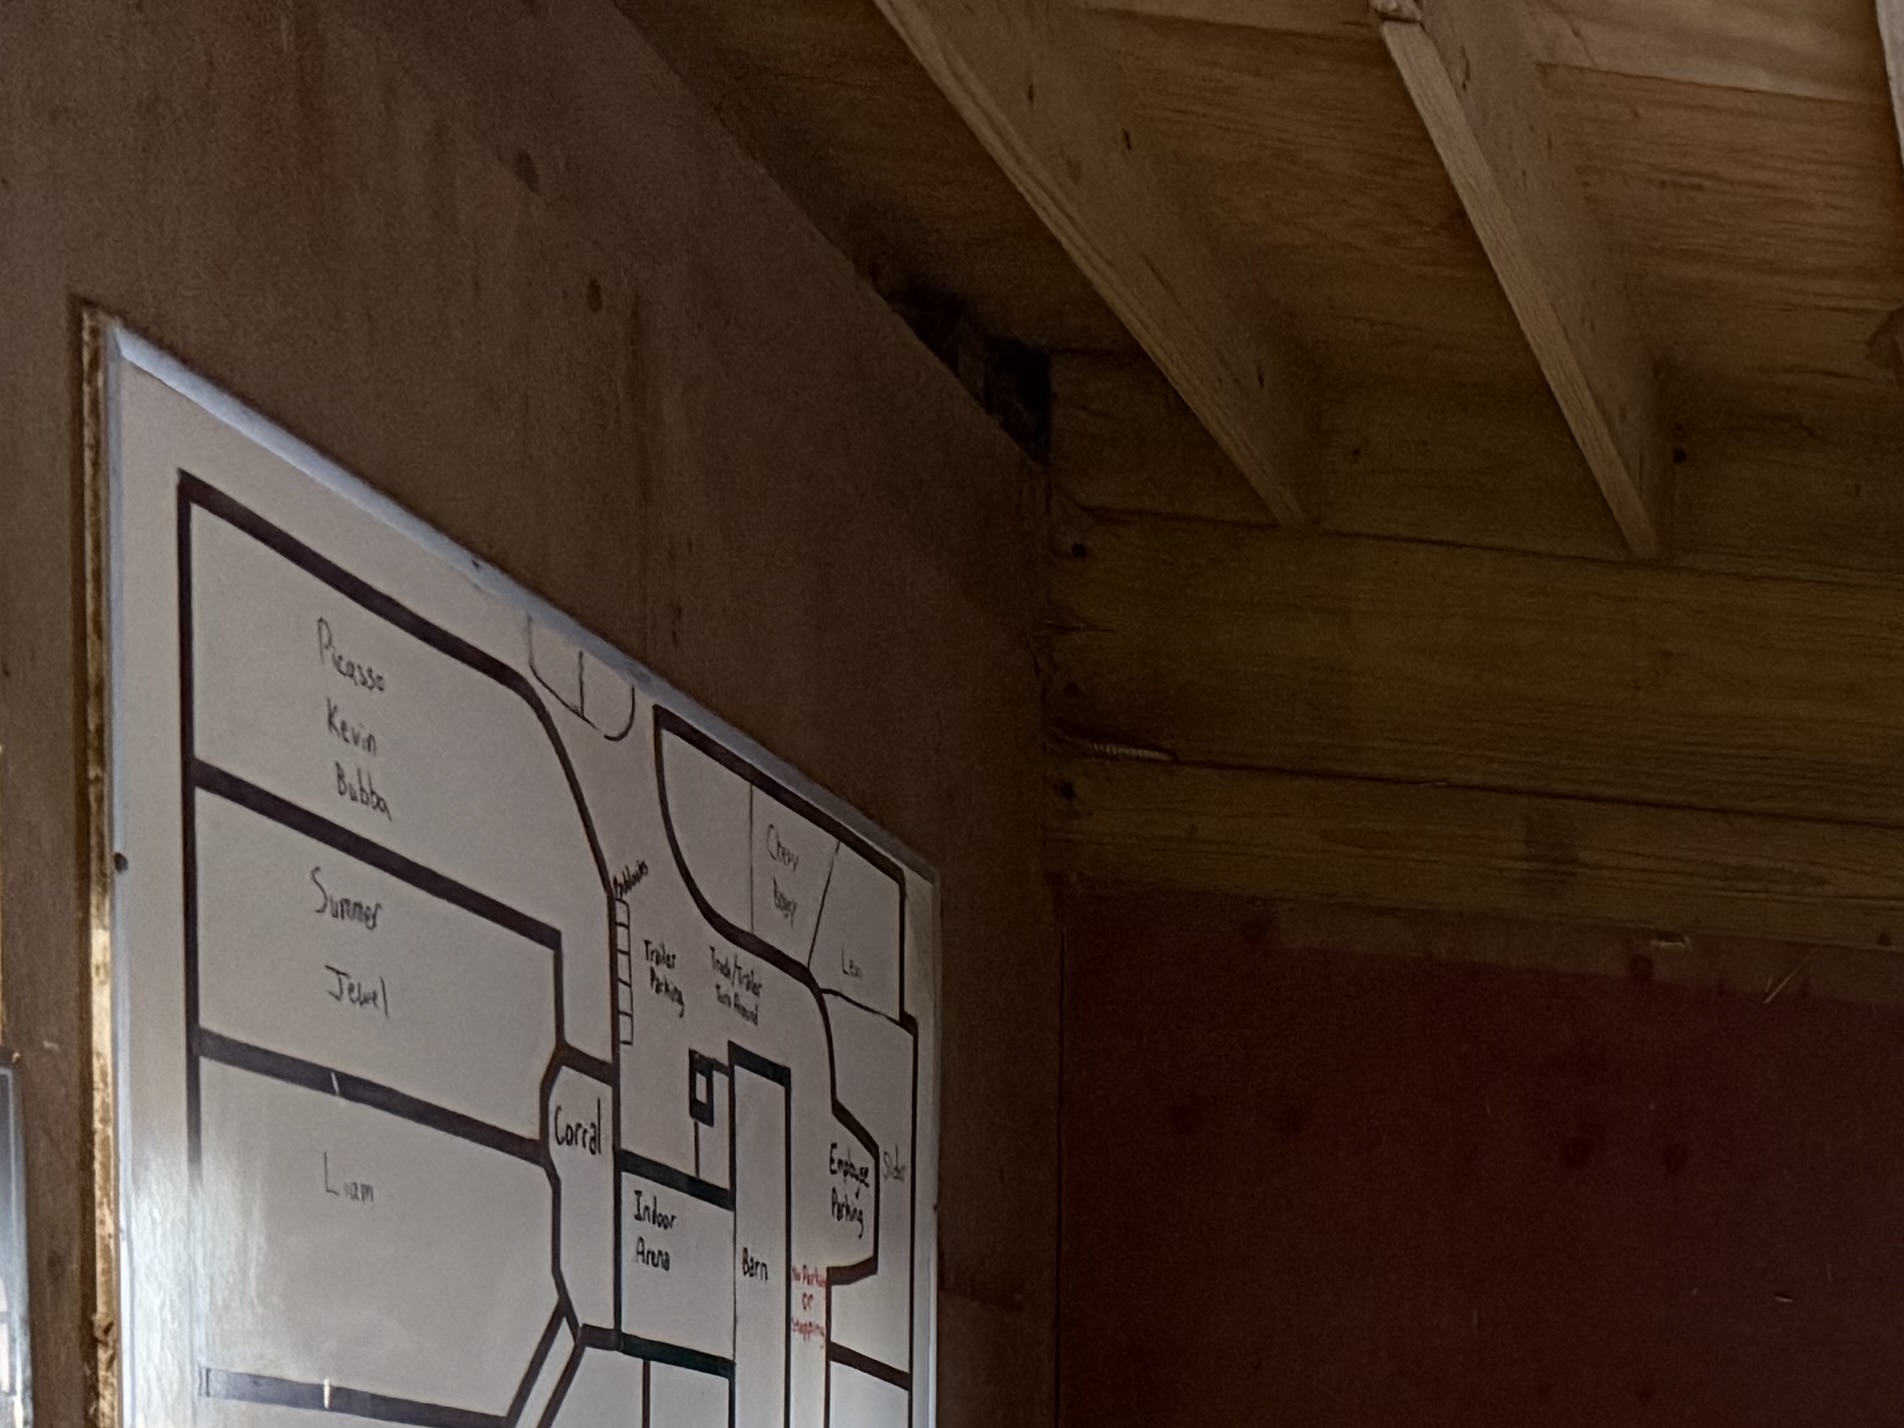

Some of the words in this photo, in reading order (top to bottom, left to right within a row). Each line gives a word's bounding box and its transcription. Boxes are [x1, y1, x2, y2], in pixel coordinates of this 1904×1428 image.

[317, 616, 386, 692] Picasso
[326, 696, 378, 757] Kevin
[334, 760, 393, 823] Bubba
[310, 865, 384, 932] Summer
[643, 939, 676, 969] Trailer
[325, 964, 389, 1019] Jewel
[650, 965, 685, 1019] Parking
[554, 1096, 602, 1156] Corral
[324, 1151, 374, 1204] Liam
[634, 1189, 677, 1230] Indoor
[832, 1186, 864, 1239] Parking
[635, 1236, 670, 1271] Arena
[742, 1247, 769, 1283] Barn
